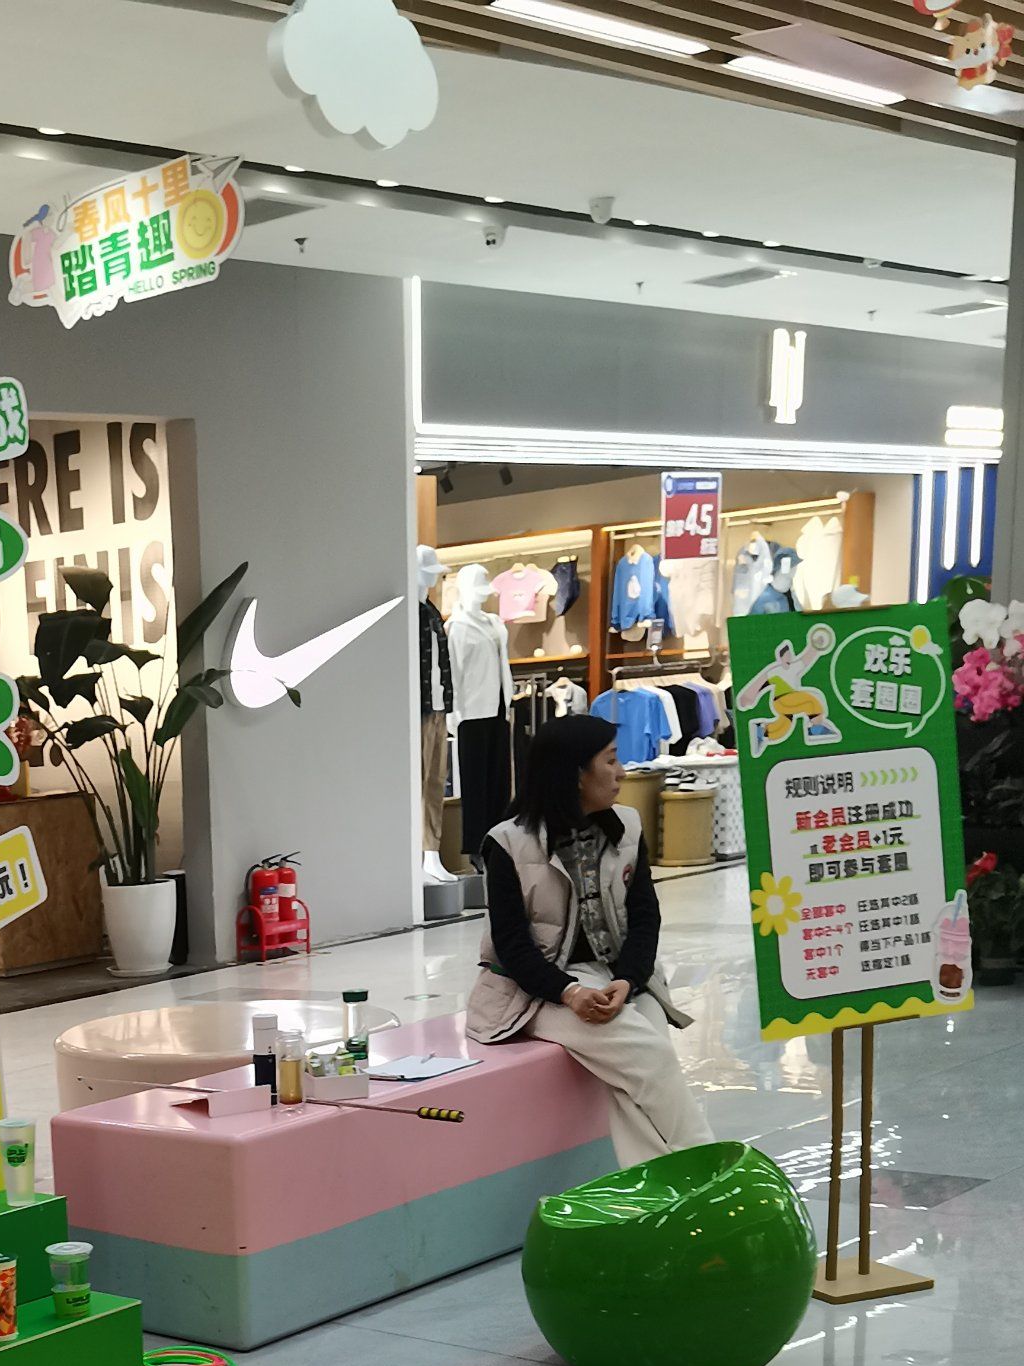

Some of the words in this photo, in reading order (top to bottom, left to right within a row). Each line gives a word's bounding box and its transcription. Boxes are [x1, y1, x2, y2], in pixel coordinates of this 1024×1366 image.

[60, 210, 175, 302] 踏青趣
[172, 261, 216, 285] SPRING
[107, 421, 160, 524] IS
[684, 503, 714, 537] 45
[864, 644, 912, 676] 欢乐
[850, 678, 923, 715] 套圈圈
[785, 771, 855, 798] 规则说明
[796, 799, 914, 831] 新会员注册成功
[809, 851, 909, 882] 即可参与套圈
